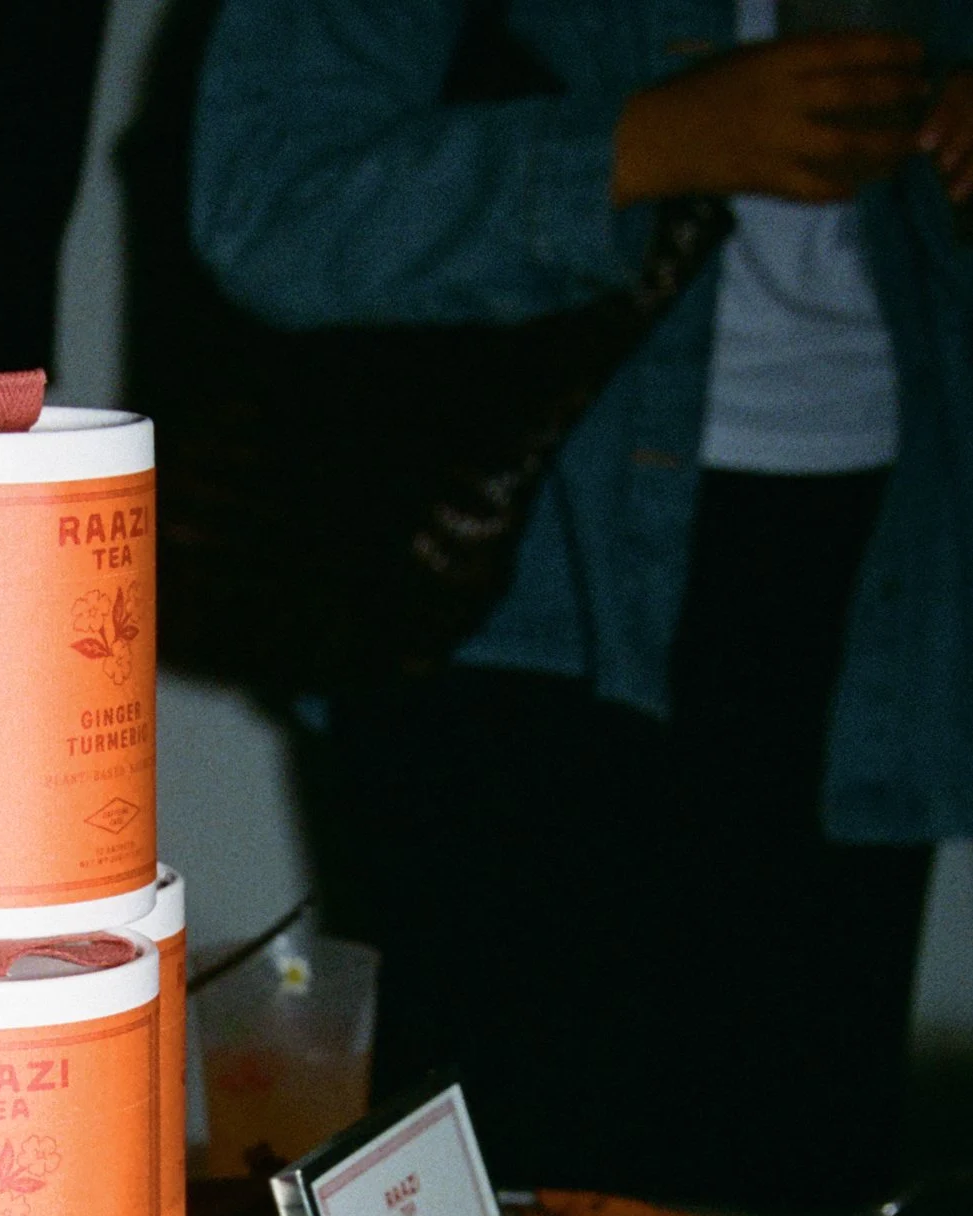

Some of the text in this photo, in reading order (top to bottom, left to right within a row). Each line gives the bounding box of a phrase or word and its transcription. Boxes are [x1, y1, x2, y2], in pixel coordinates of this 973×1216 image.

[58, 507, 149, 547] RAAZI
[91, 544, 133, 570] TEA
[80, 701, 141, 731] GINGER
[66, 723, 149, 757] TURMERIC
